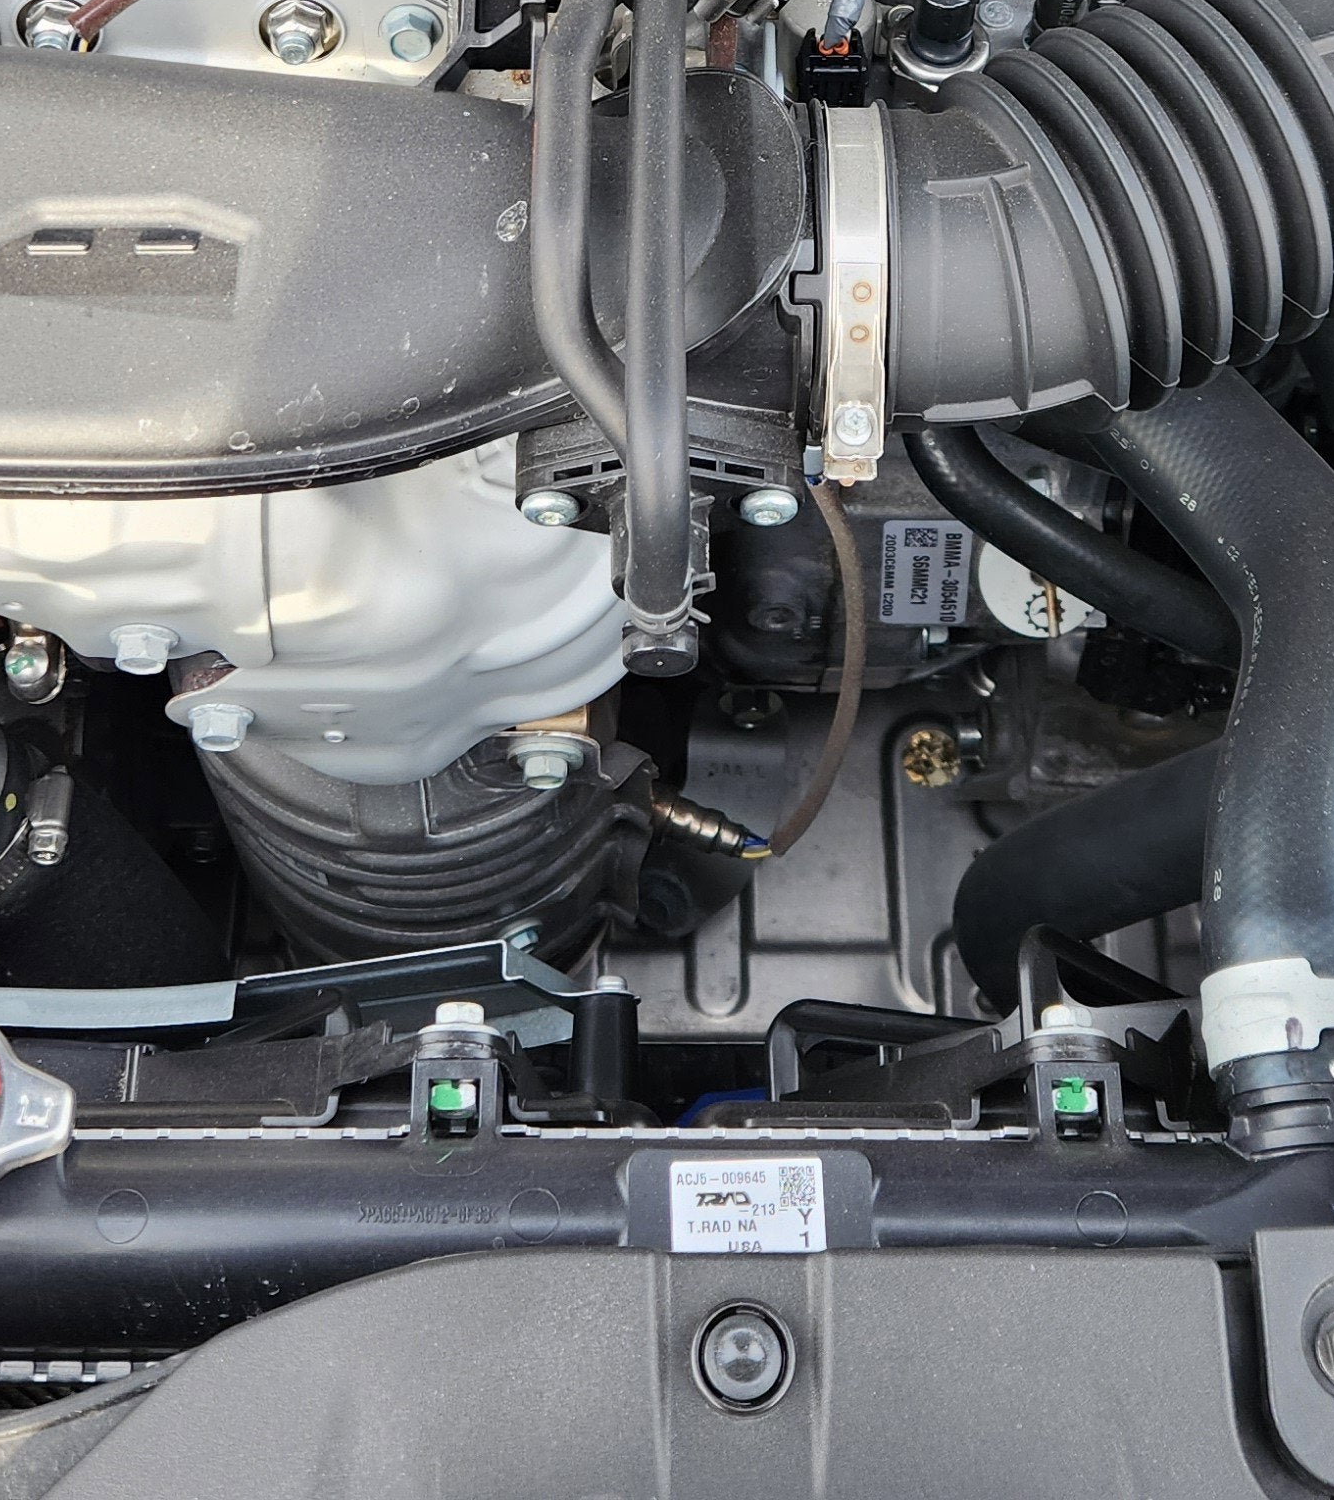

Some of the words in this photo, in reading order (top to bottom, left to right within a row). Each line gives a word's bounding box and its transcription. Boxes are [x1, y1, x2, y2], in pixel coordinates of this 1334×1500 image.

[1178, 492, 1198, 513] 28
[910, 555, 931, 606] S6MMC21
[881, 592, 895, 617] C200
[676, 1171, 767, 1186] ACJ5-009645
[798, 1208, 813, 1226] Y
[687, 1220, 732, 1234] T.RAD
[738, 1219, 758, 1233] NA
[728, 1241, 763, 1252] USA
[799, 1231, 810, 1249] 1
